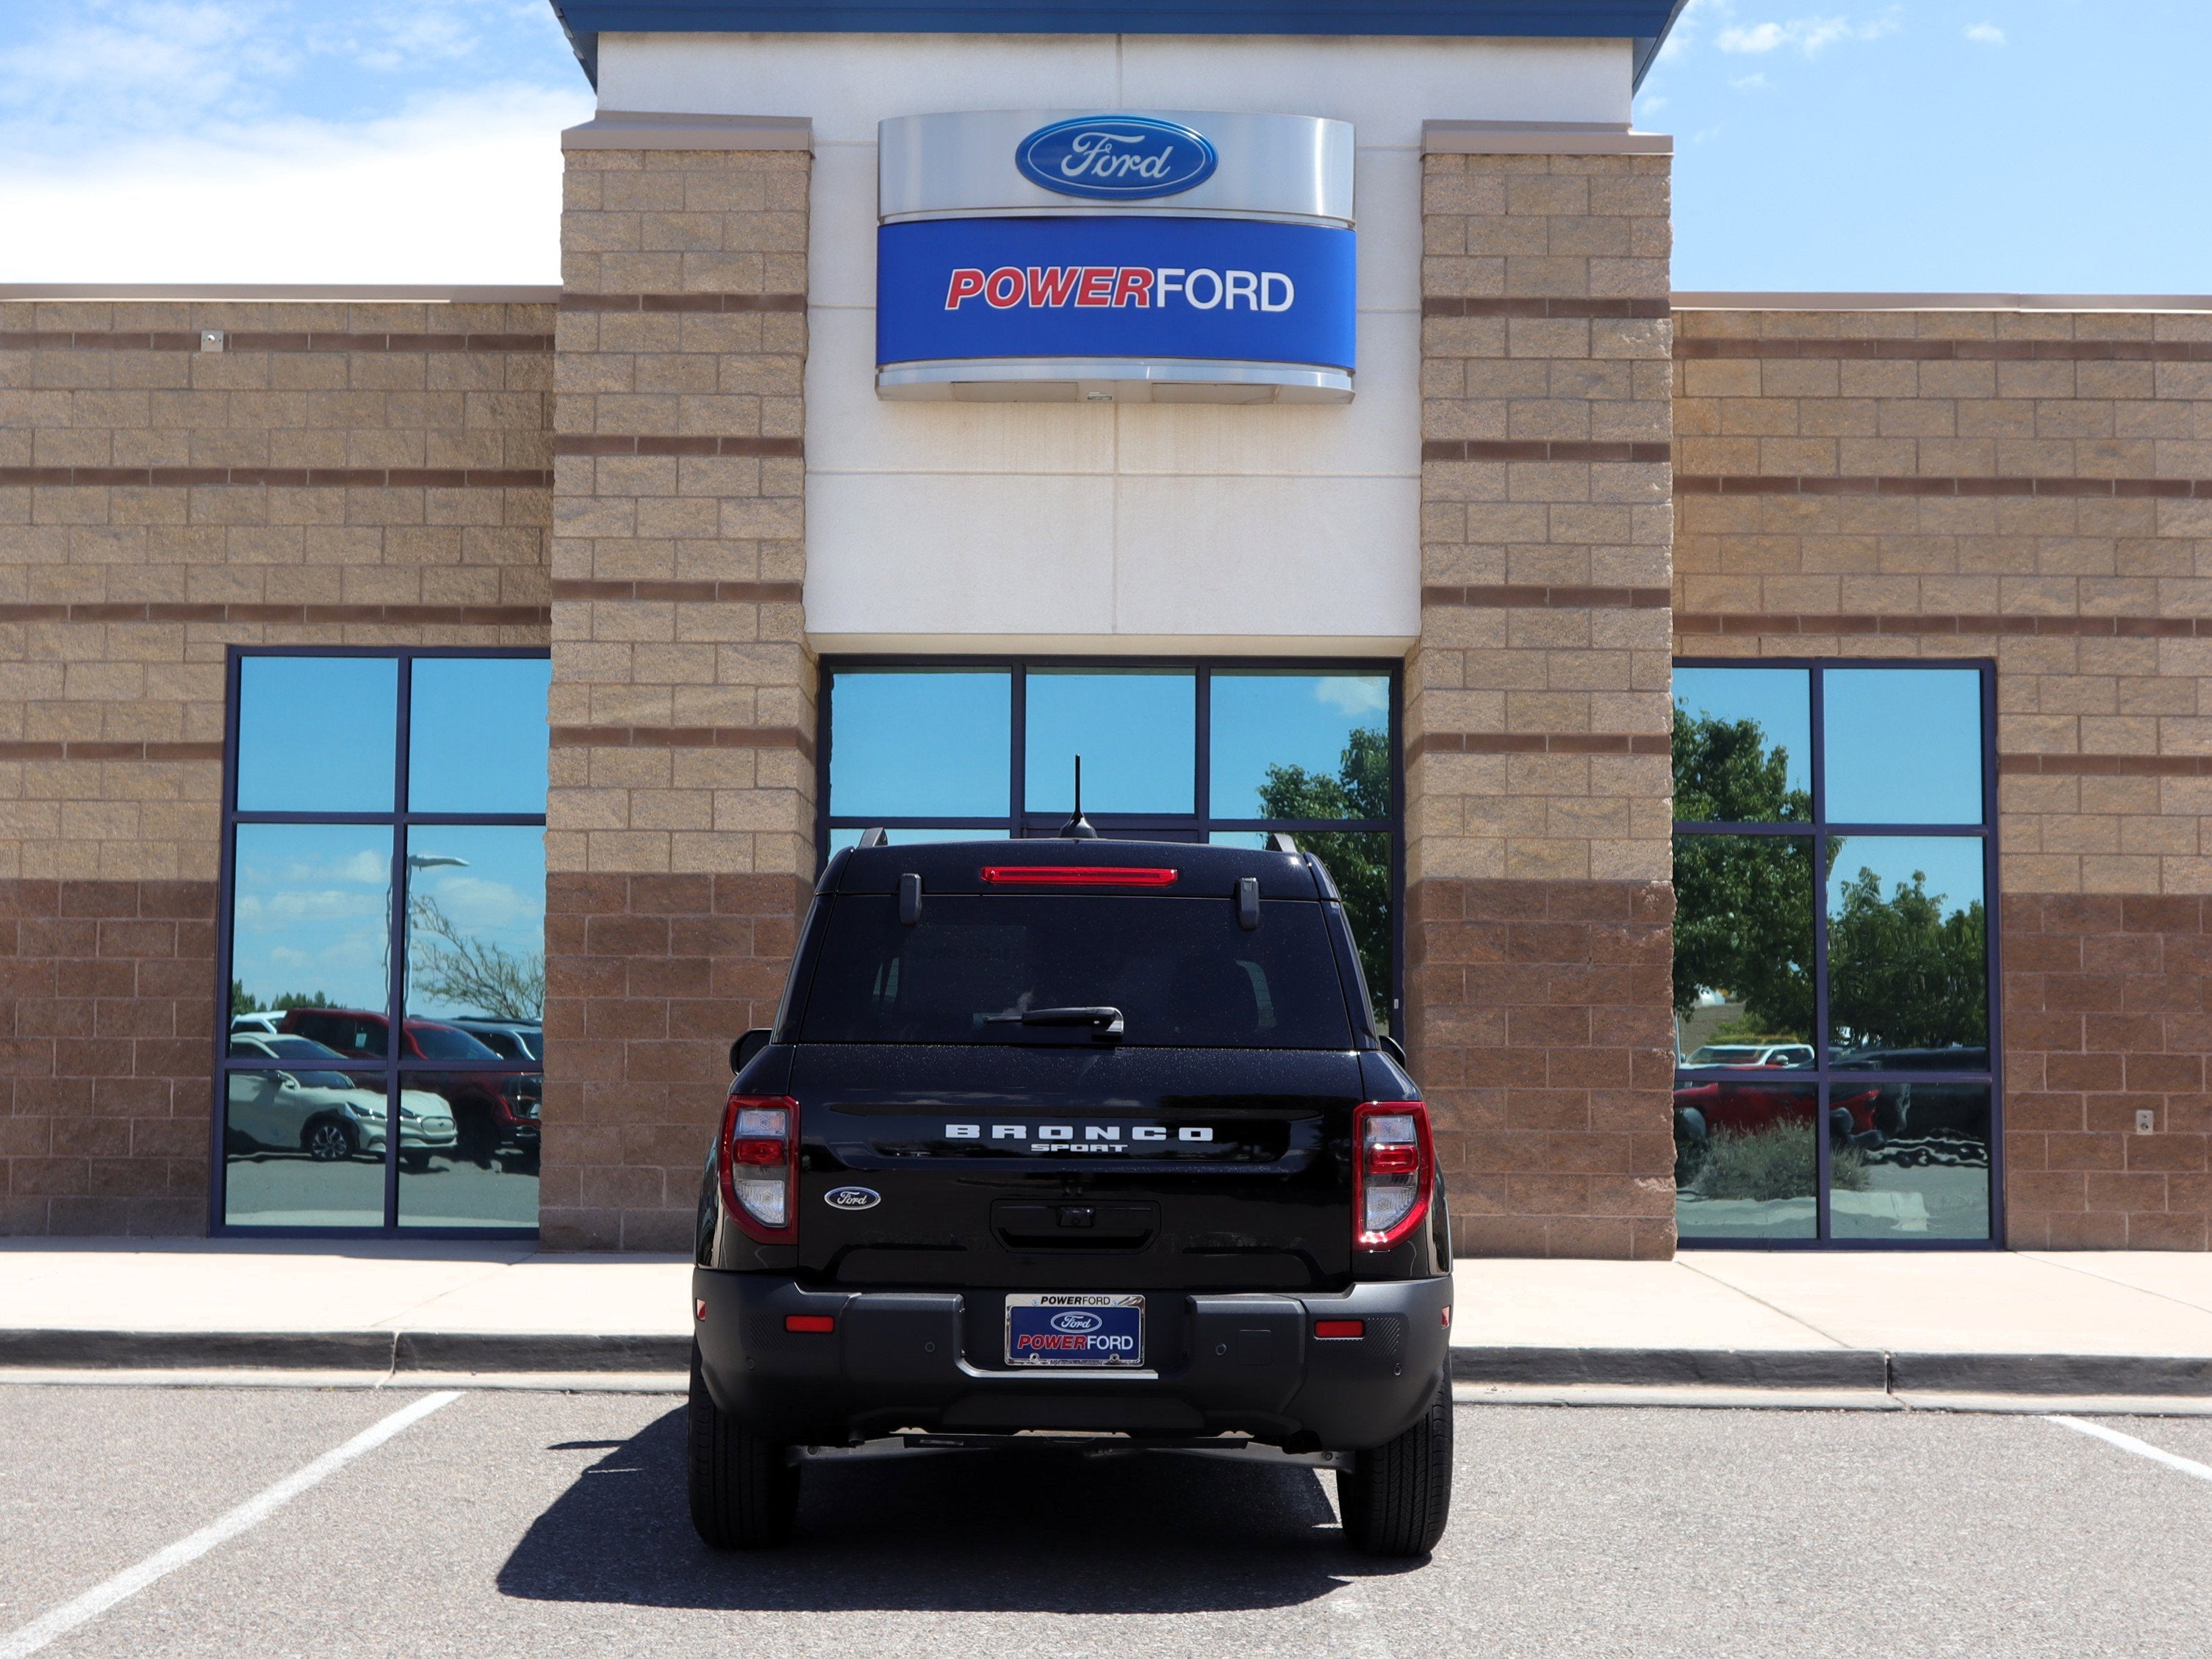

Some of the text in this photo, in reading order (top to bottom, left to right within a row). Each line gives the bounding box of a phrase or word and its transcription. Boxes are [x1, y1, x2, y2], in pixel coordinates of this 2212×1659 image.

[1060, 131, 1174, 179] Ford
[945, 1123, 1214, 1142] BRONCO
[1030, 1143, 1129, 1153] SPORT
[836, 1190, 868, 1205] Ford
[1060, 1314, 1092, 1329] Ford
